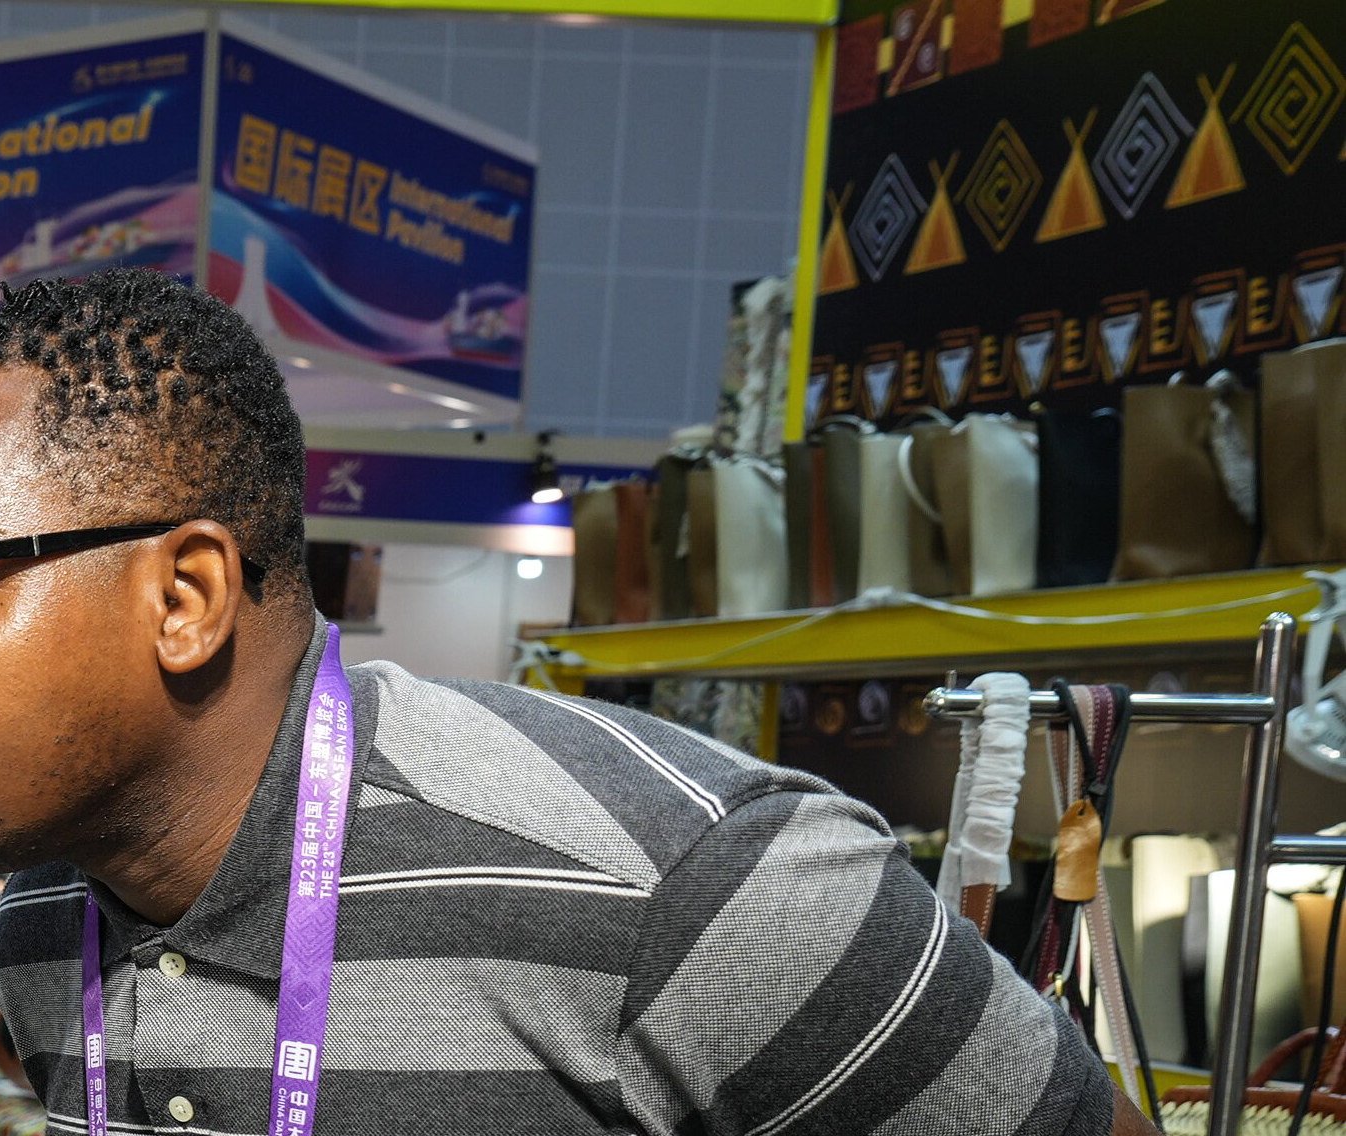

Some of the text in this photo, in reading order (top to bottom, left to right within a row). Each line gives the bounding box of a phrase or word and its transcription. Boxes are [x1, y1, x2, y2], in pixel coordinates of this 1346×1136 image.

[235, 113, 388, 235] 国际展区
[389, 169, 516, 244] International
[386, 209, 464, 264] Pavilion
[337, 701, 348, 732] EXPO
[325, 734, 347, 840] CHINA-ASEAN
[320, 870, 334, 899] THE
[277, 1087, 287, 1118] CHINA
